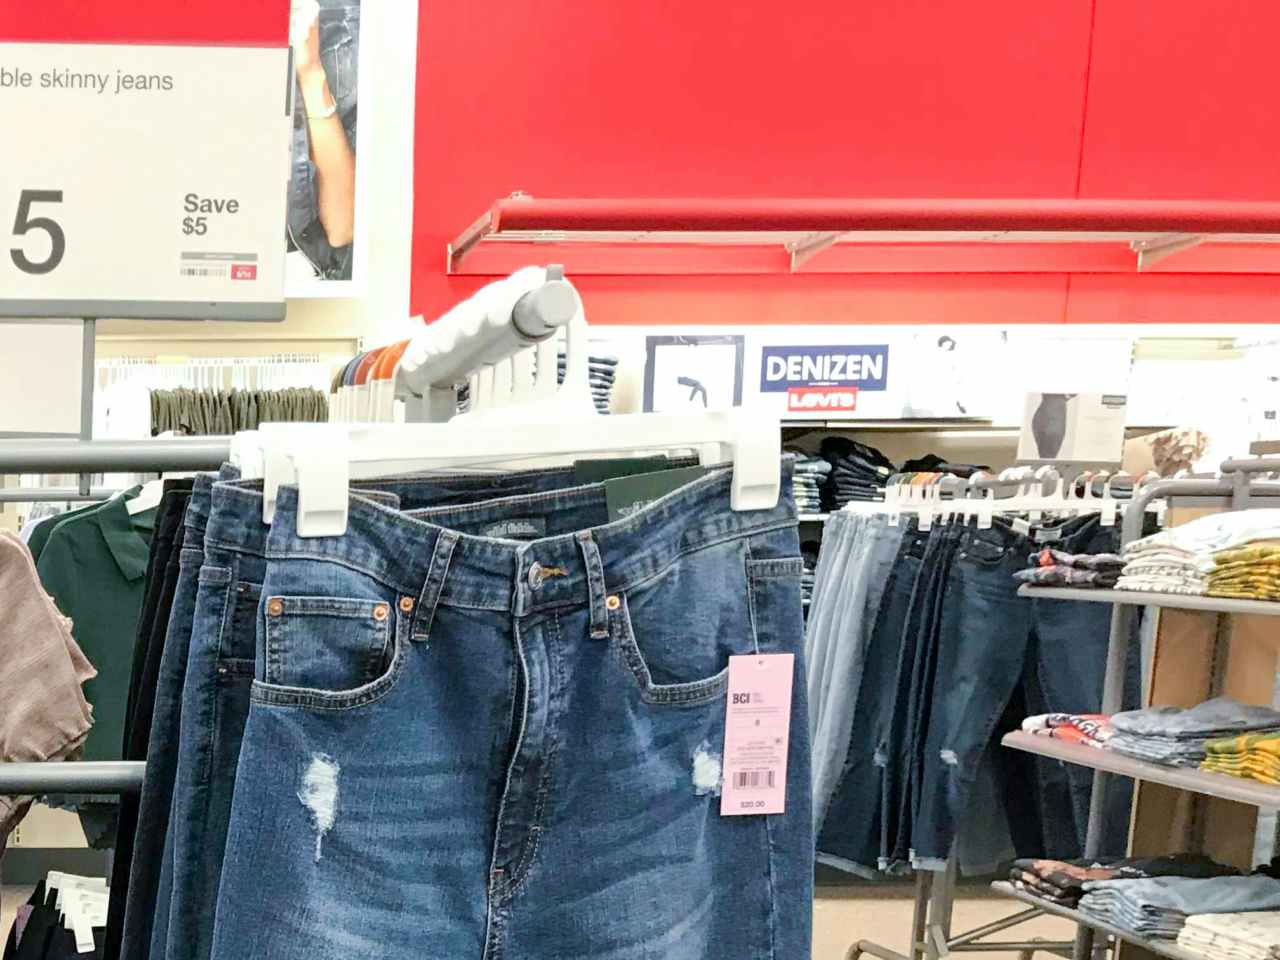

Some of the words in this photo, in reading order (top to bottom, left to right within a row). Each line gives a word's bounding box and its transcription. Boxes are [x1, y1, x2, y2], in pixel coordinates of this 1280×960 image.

[39, 69, 109, 94] skinny
[115, 70, 174, 94] jeans
[184, 193, 239, 214] Save
[182, 216, 208, 236] $5
[765, 354, 884, 381] DENIZEN
